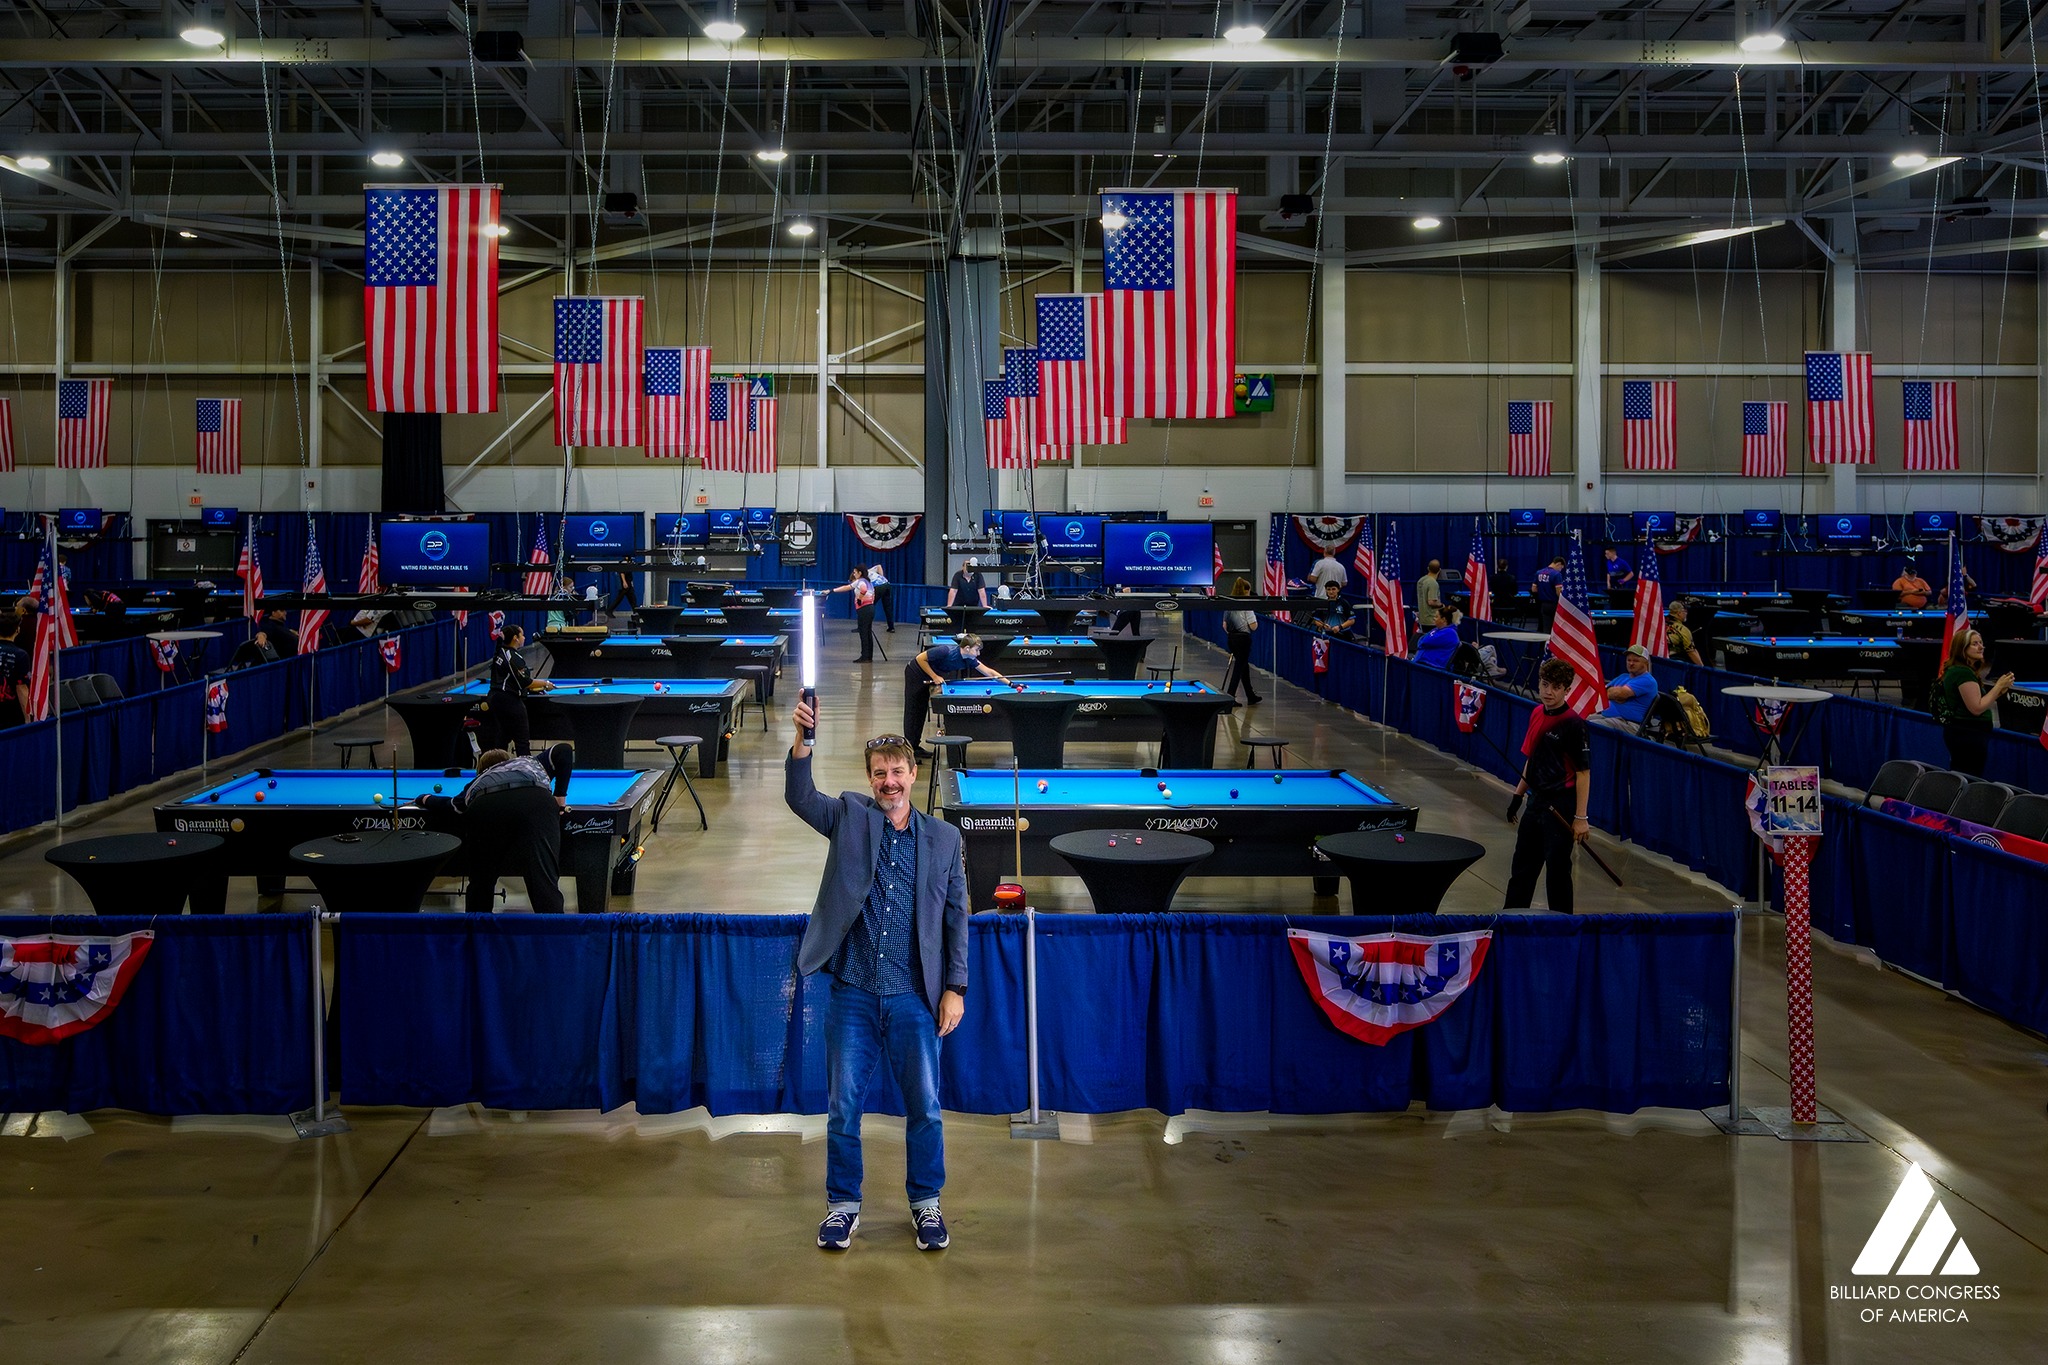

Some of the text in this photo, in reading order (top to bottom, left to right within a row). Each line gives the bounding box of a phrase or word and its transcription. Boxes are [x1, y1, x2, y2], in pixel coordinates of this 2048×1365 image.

[1201, 497, 1211, 505] EXIT
[1538, 574, 1550, 583] USA
[1773, 781, 1815, 790] TABLES
[1771, 796, 1818, 813] 11-14
[189, 818, 230, 828] aramith
[974, 816, 1016, 826] aramith
[1153, 817, 1210, 832] DIAMOND
